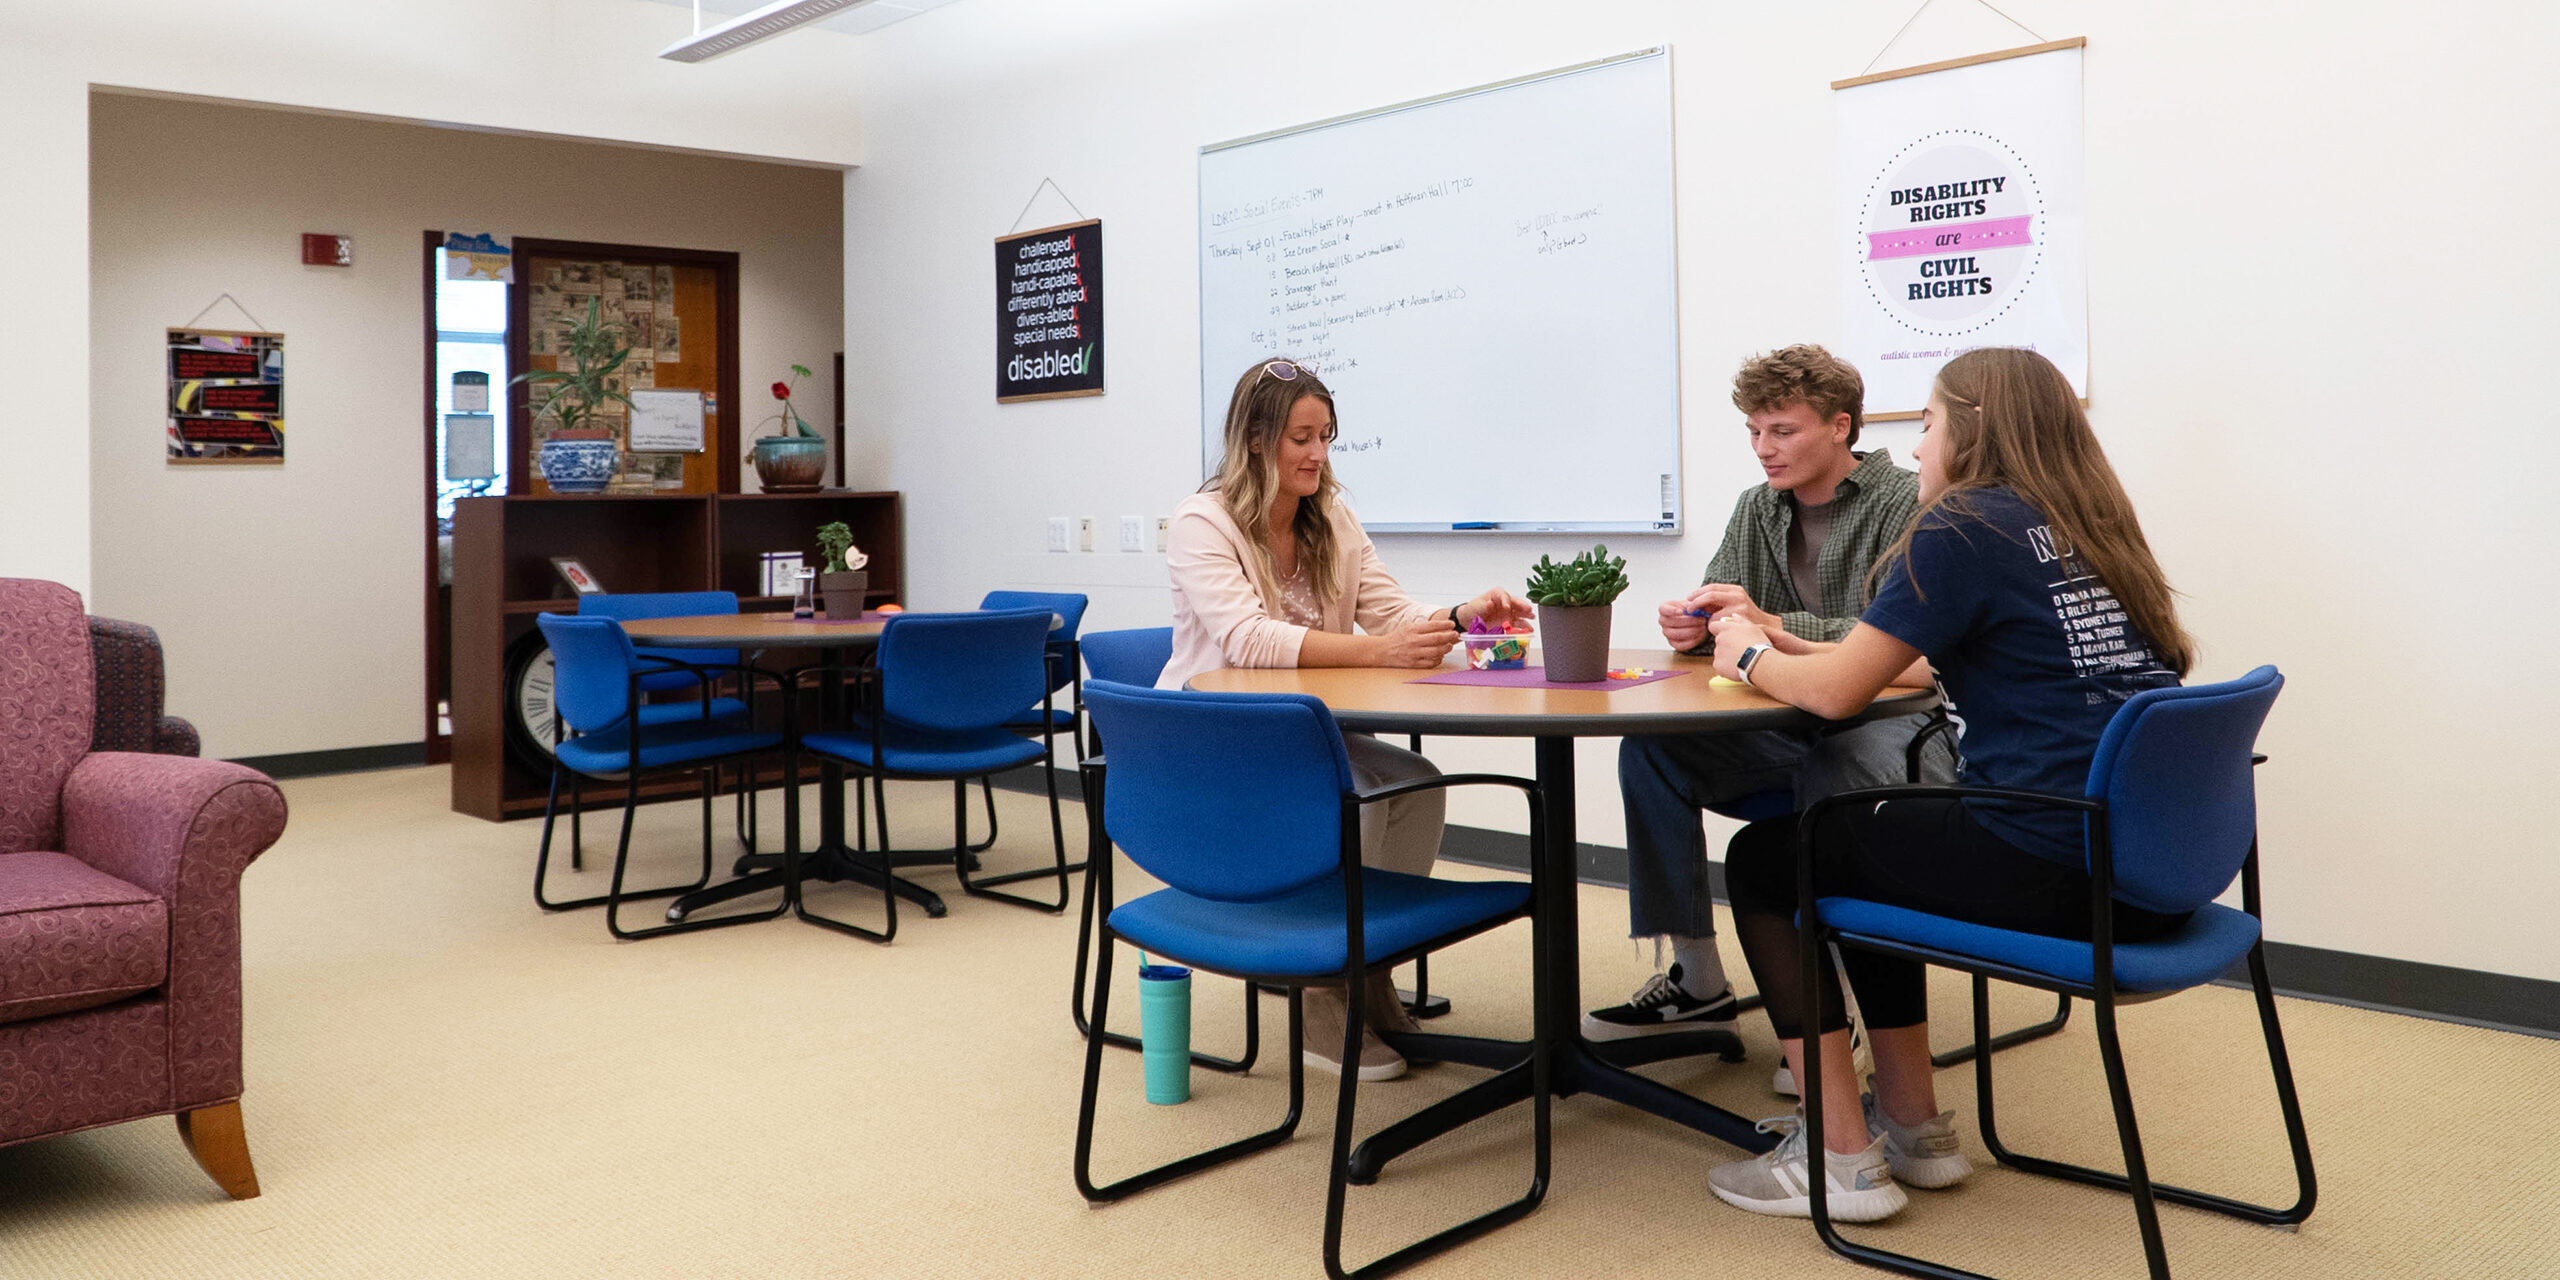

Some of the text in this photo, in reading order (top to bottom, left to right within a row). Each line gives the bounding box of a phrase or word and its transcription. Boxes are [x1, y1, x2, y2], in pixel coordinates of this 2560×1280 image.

[1890, 176, 2007, 207] DISABILITY
[1336, 214, 1354, 229] Play
[1909, 199, 1987, 223] RIGHTS
[1019, 236, 1071, 259] challenged
[1935, 232, 1962, 247] are
[1014, 252, 1076, 277] handicapped
[1920, 256, 1980, 278] CIVIL
[1011, 271, 1078, 295] handi-capable
[1907, 277, 1993, 301] RIGHTS
[1008, 286, 1084, 313] differently abled
[1016, 305, 1075, 328] divers-abled
[1013, 324, 1078, 347] special needs
[1008, 346, 1083, 382] disabled
[1880, 351, 1911, 361] autistic
[1912, 348, 1942, 359] women
[2057, 608, 2066, 620] 2
[2066, 602, 2093, 617] RILEY
[2063, 620, 2072, 632] 4
[2072, 614, 2107, 630] SYDNEY
[2094, 626, 2125, 640] TURNER
[2069, 639, 2128, 658] 10 MAYA KARL
